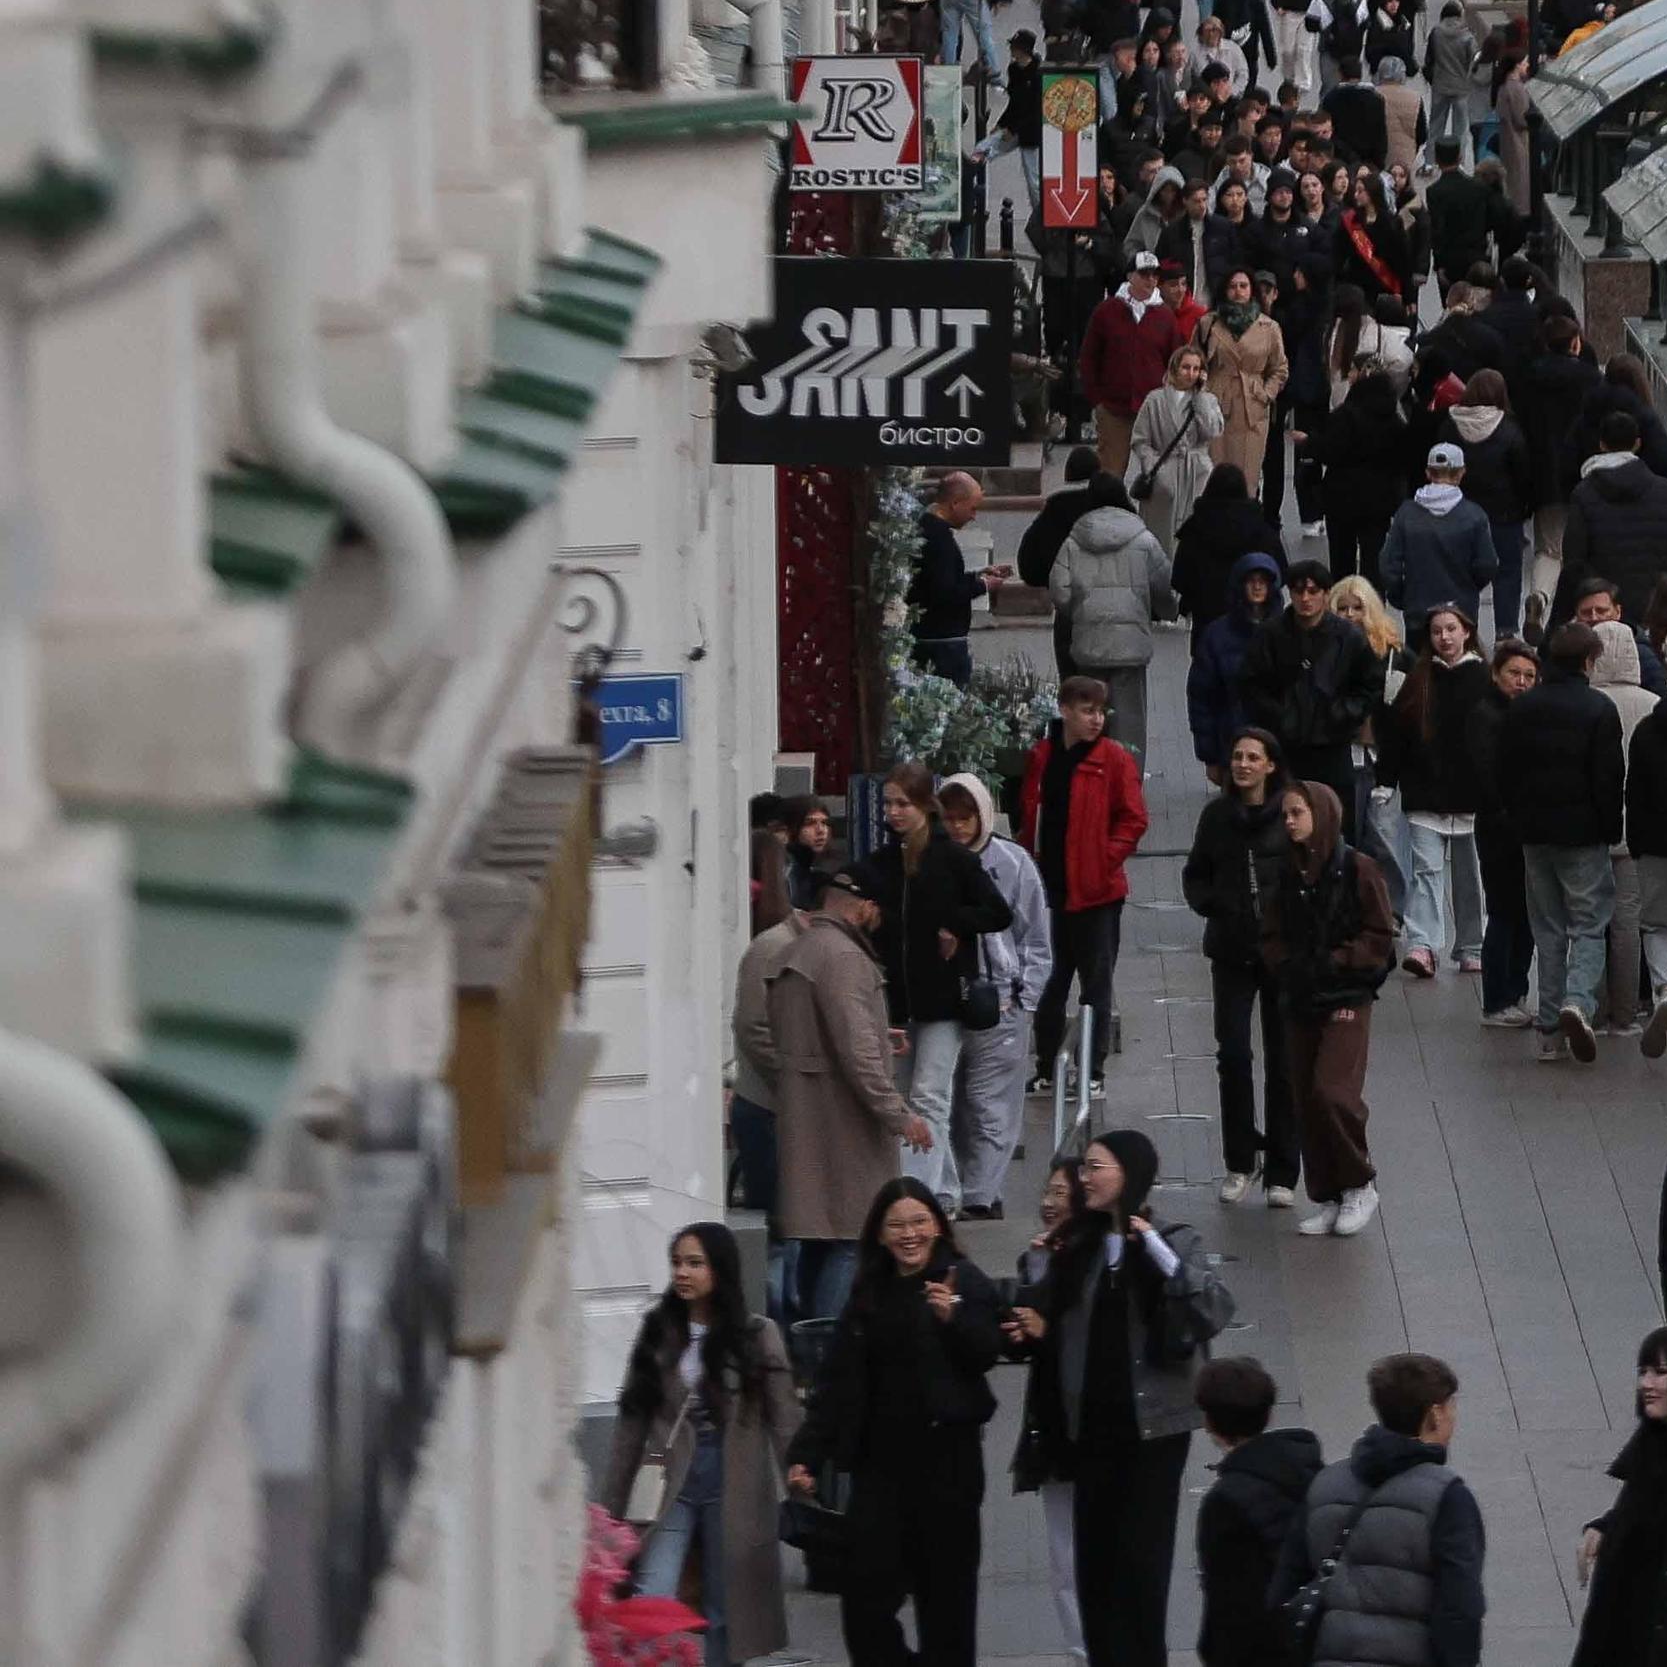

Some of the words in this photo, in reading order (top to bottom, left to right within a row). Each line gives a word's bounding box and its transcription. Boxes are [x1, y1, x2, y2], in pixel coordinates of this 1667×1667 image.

[811, 77, 897, 143] R
[792, 168, 921, 187] ROSTIC'S
[879, 420, 985, 449] бистро
[657, 698, 674, 722] 8
